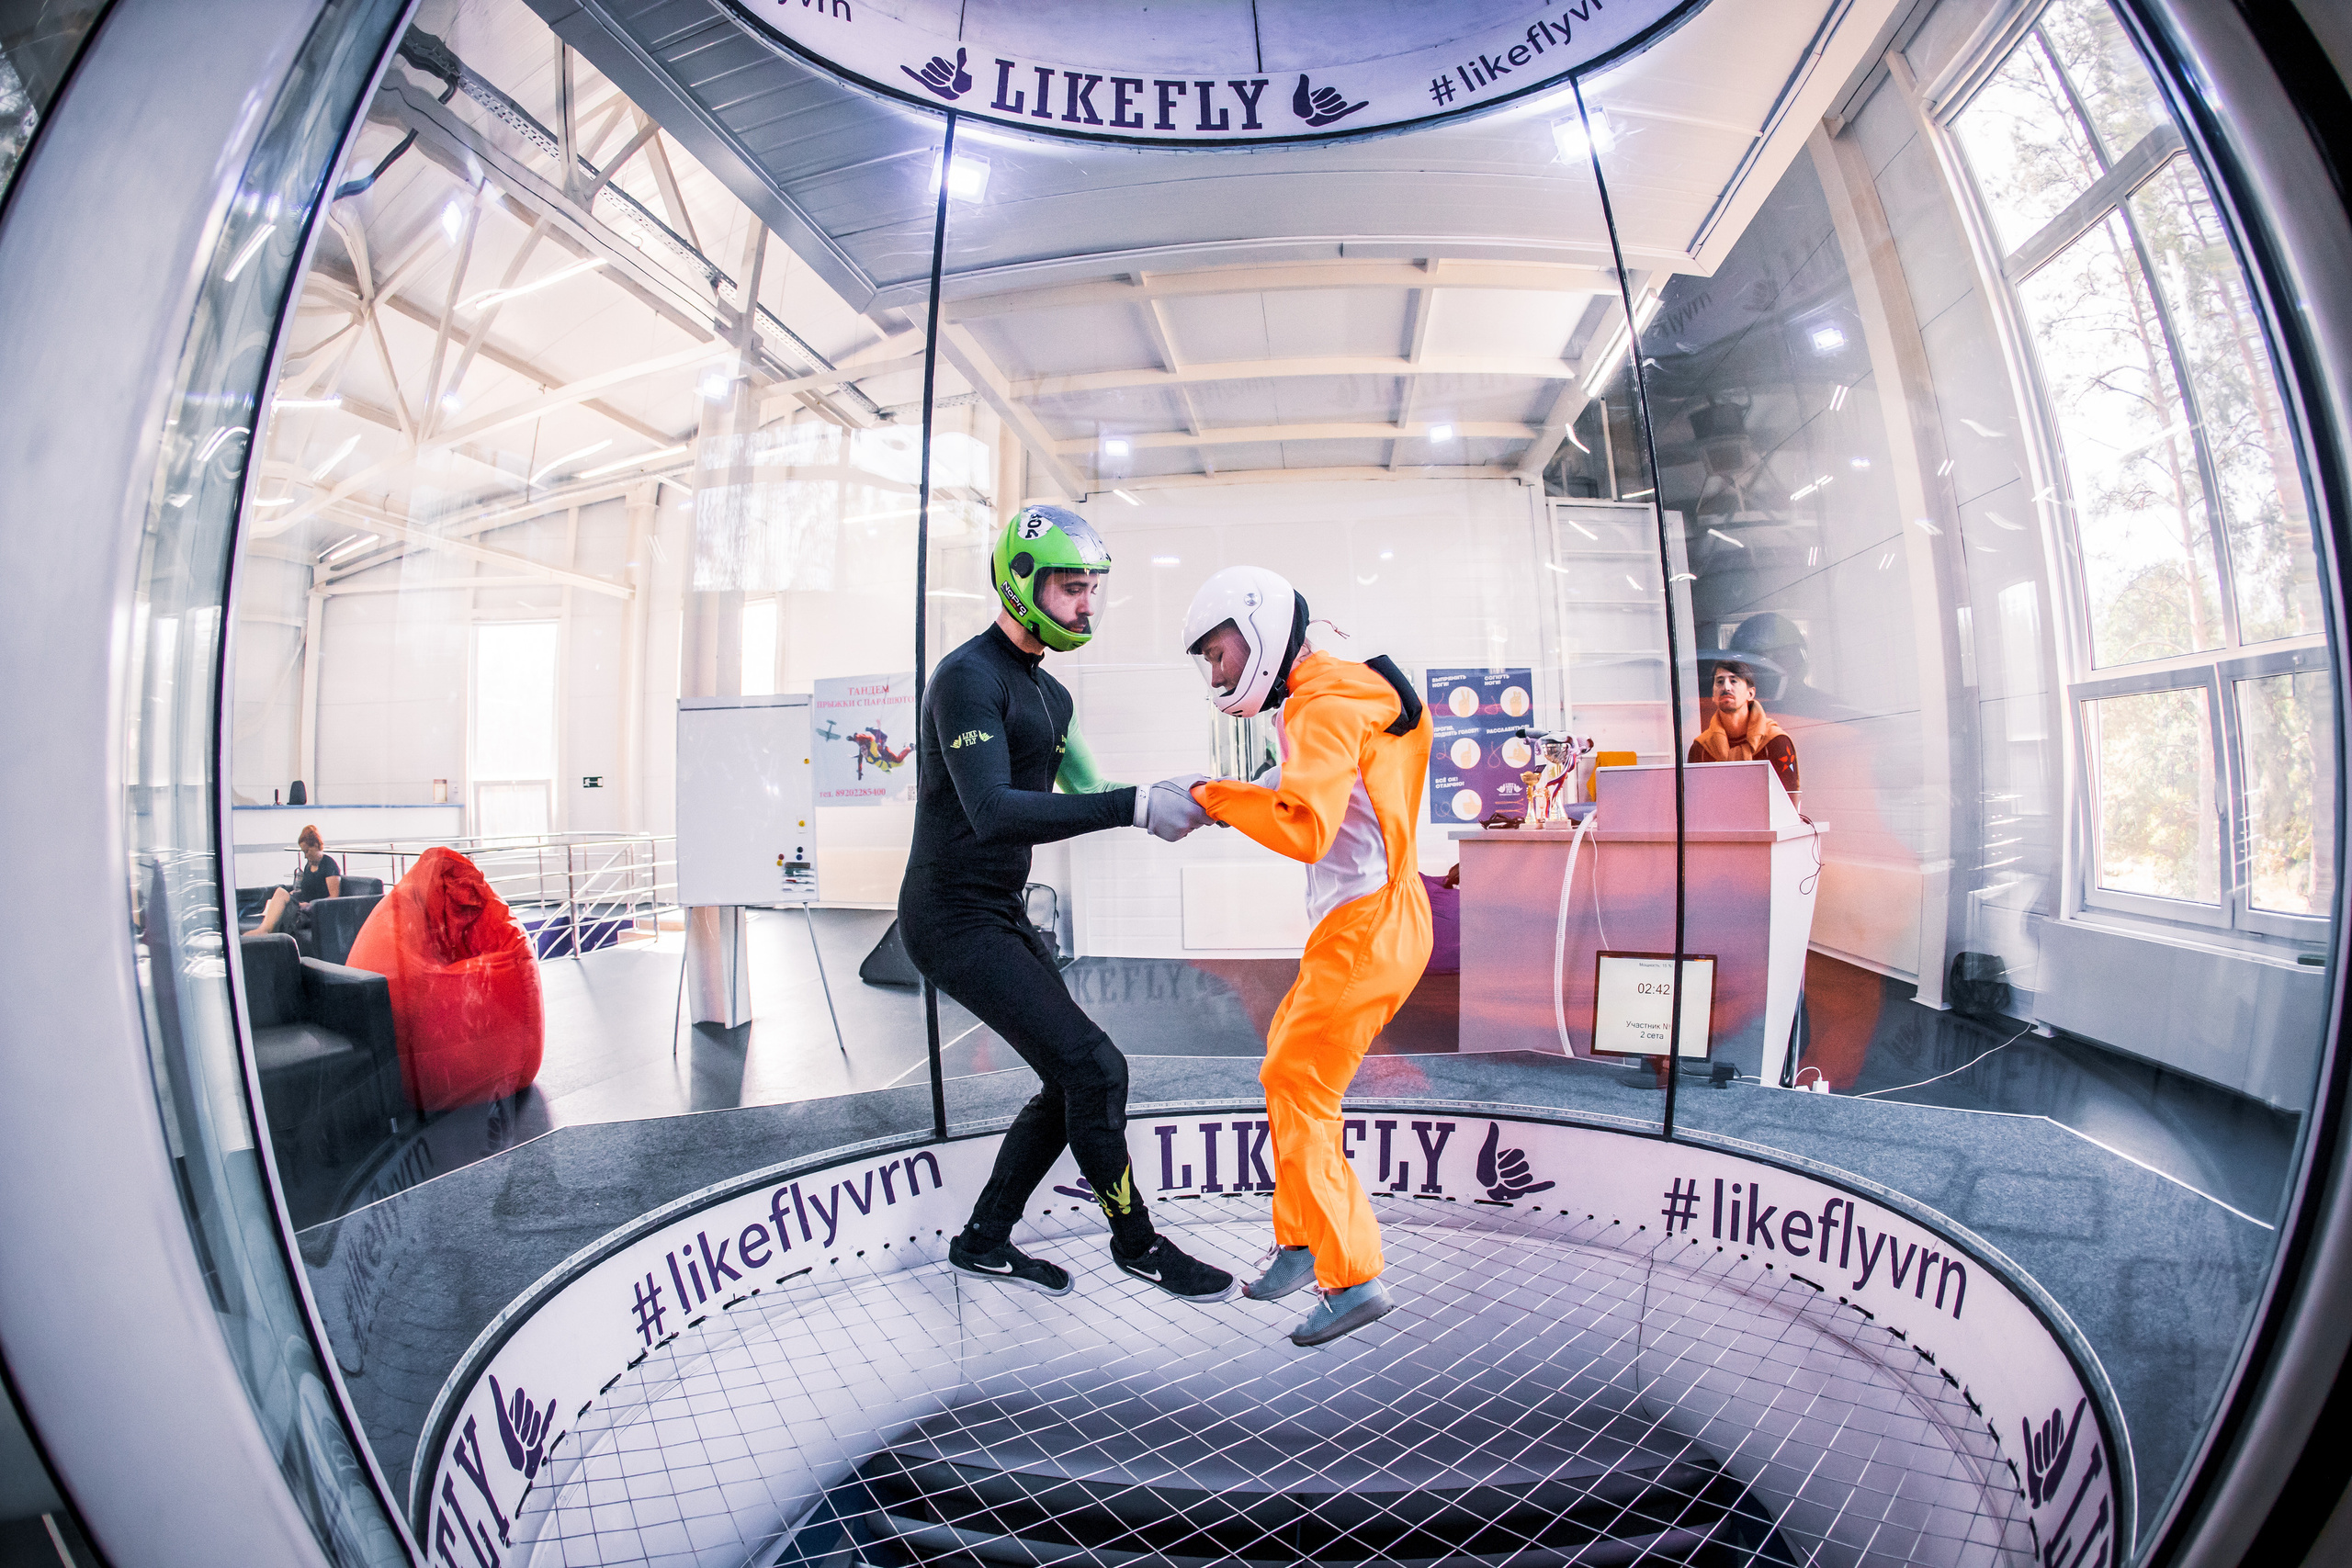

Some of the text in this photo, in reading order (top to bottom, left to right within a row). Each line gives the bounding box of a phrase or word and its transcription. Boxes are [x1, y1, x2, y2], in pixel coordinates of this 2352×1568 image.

[990, 58, 1270, 131] LIKEFLY
[848, 685, 889, 696] ТАНДЕМ
[865, 697, 914, 706] ПАРАШЮТО
[962, 729, 978, 740] LIKE
[965, 737, 977, 747] FLY
[1638, 982, 1670, 994] 02:42
[1626, 1021, 1661, 1029] Участник
[1154, 1119, 1456, 1194] LIKFLY
[631, 1150, 943, 1348] #likeflyvrn
[1661, 1177, 1967, 1321] #likeflyvrn
